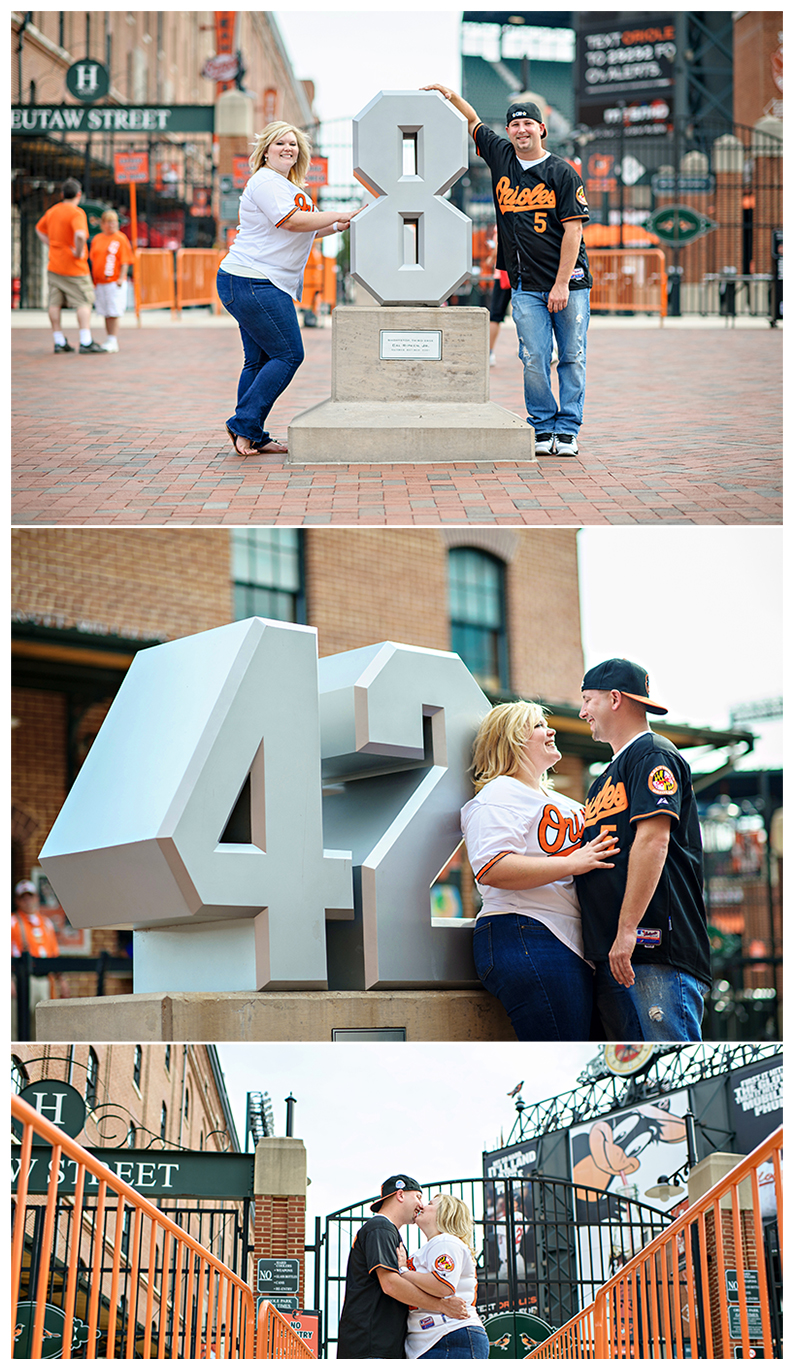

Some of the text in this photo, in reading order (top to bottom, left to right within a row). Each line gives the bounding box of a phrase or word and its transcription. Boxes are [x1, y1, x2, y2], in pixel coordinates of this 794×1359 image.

[76, 65, 100, 90] H
[11, 108, 172, 130] EUTAW STREET
[351, 90, 472, 307] 8
[495, 175, 556, 214] Orioles
[534, 211, 547, 234] 5
[38, 615, 492, 992] 42
[32, 1092, 68, 1125] H
[259, 1269, 273, 1281] NO
[498, 1295, 538, 1311] ORILES
[290, 1321, 303, 1330] NO
